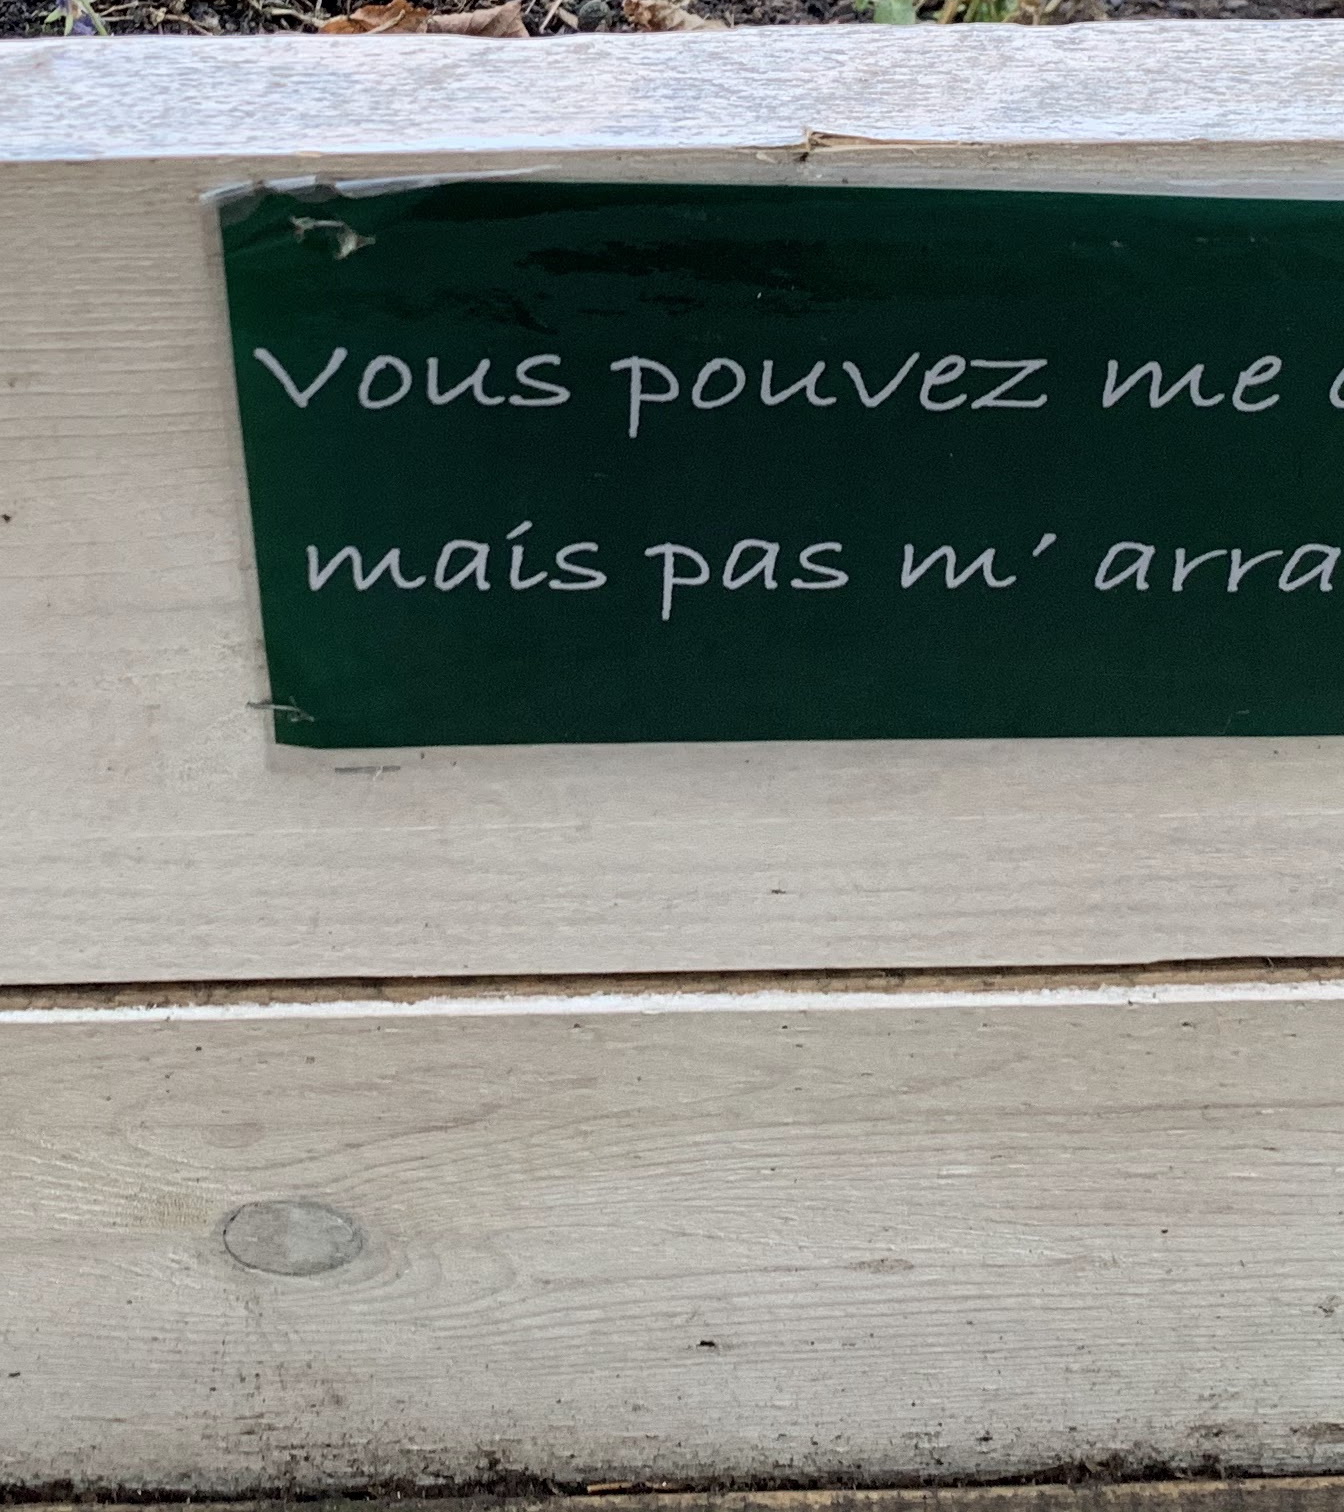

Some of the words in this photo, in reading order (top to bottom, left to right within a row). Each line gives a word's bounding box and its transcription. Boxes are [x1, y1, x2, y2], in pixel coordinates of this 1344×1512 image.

[254, 346, 571, 410] Vous
[609, 352, 1049, 439] pouvez
[1100, 353, 1284, 414] me
[305, 519, 609, 593] mais
[642, 537, 851, 622] pas
